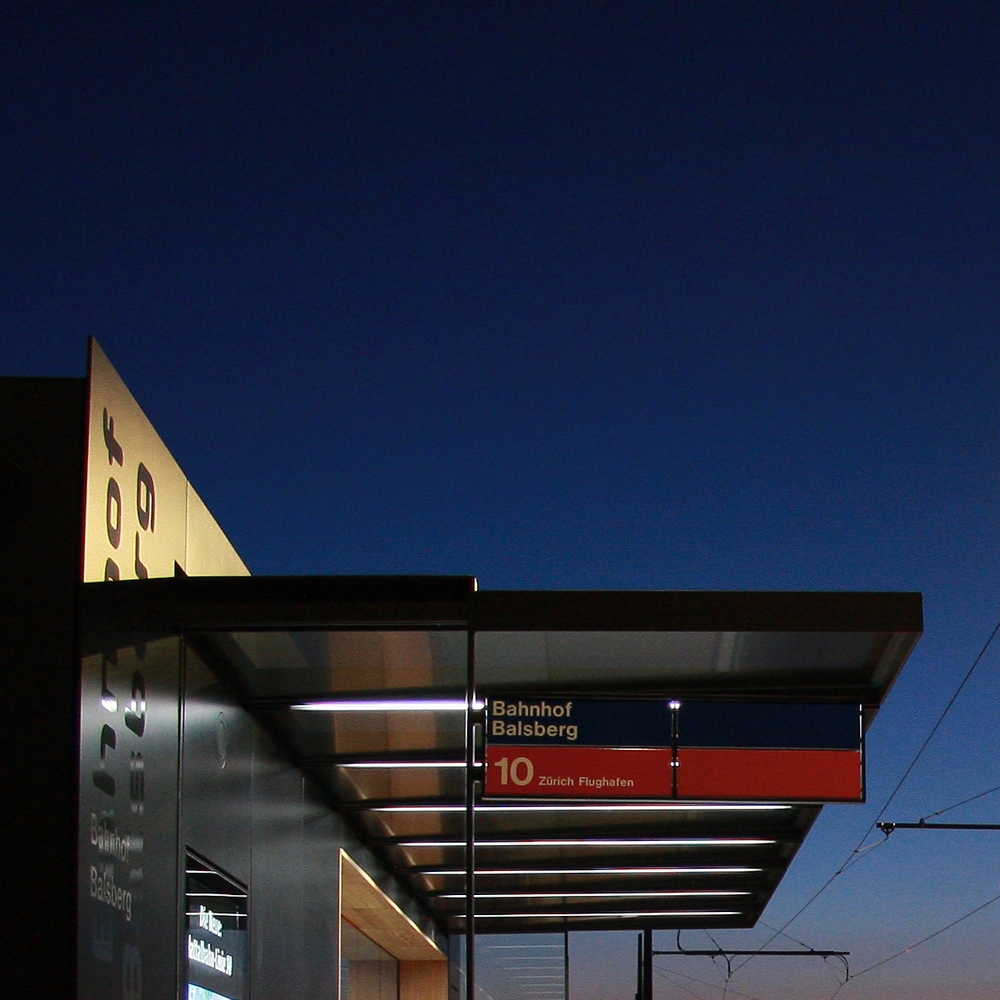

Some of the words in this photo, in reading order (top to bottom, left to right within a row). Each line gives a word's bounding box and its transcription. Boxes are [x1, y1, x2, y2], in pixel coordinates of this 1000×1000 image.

[492, 700, 572, 717] Bahnhof
[492, 720, 578, 740] Balsberg
[494, 756, 534, 786] 10
[538, 776, 574, 787] Zürich
[578, 776, 634, 789] Flughafen
[91, 813, 130, 862] Bahnhof
[90, 865, 132, 922] Balsberg
